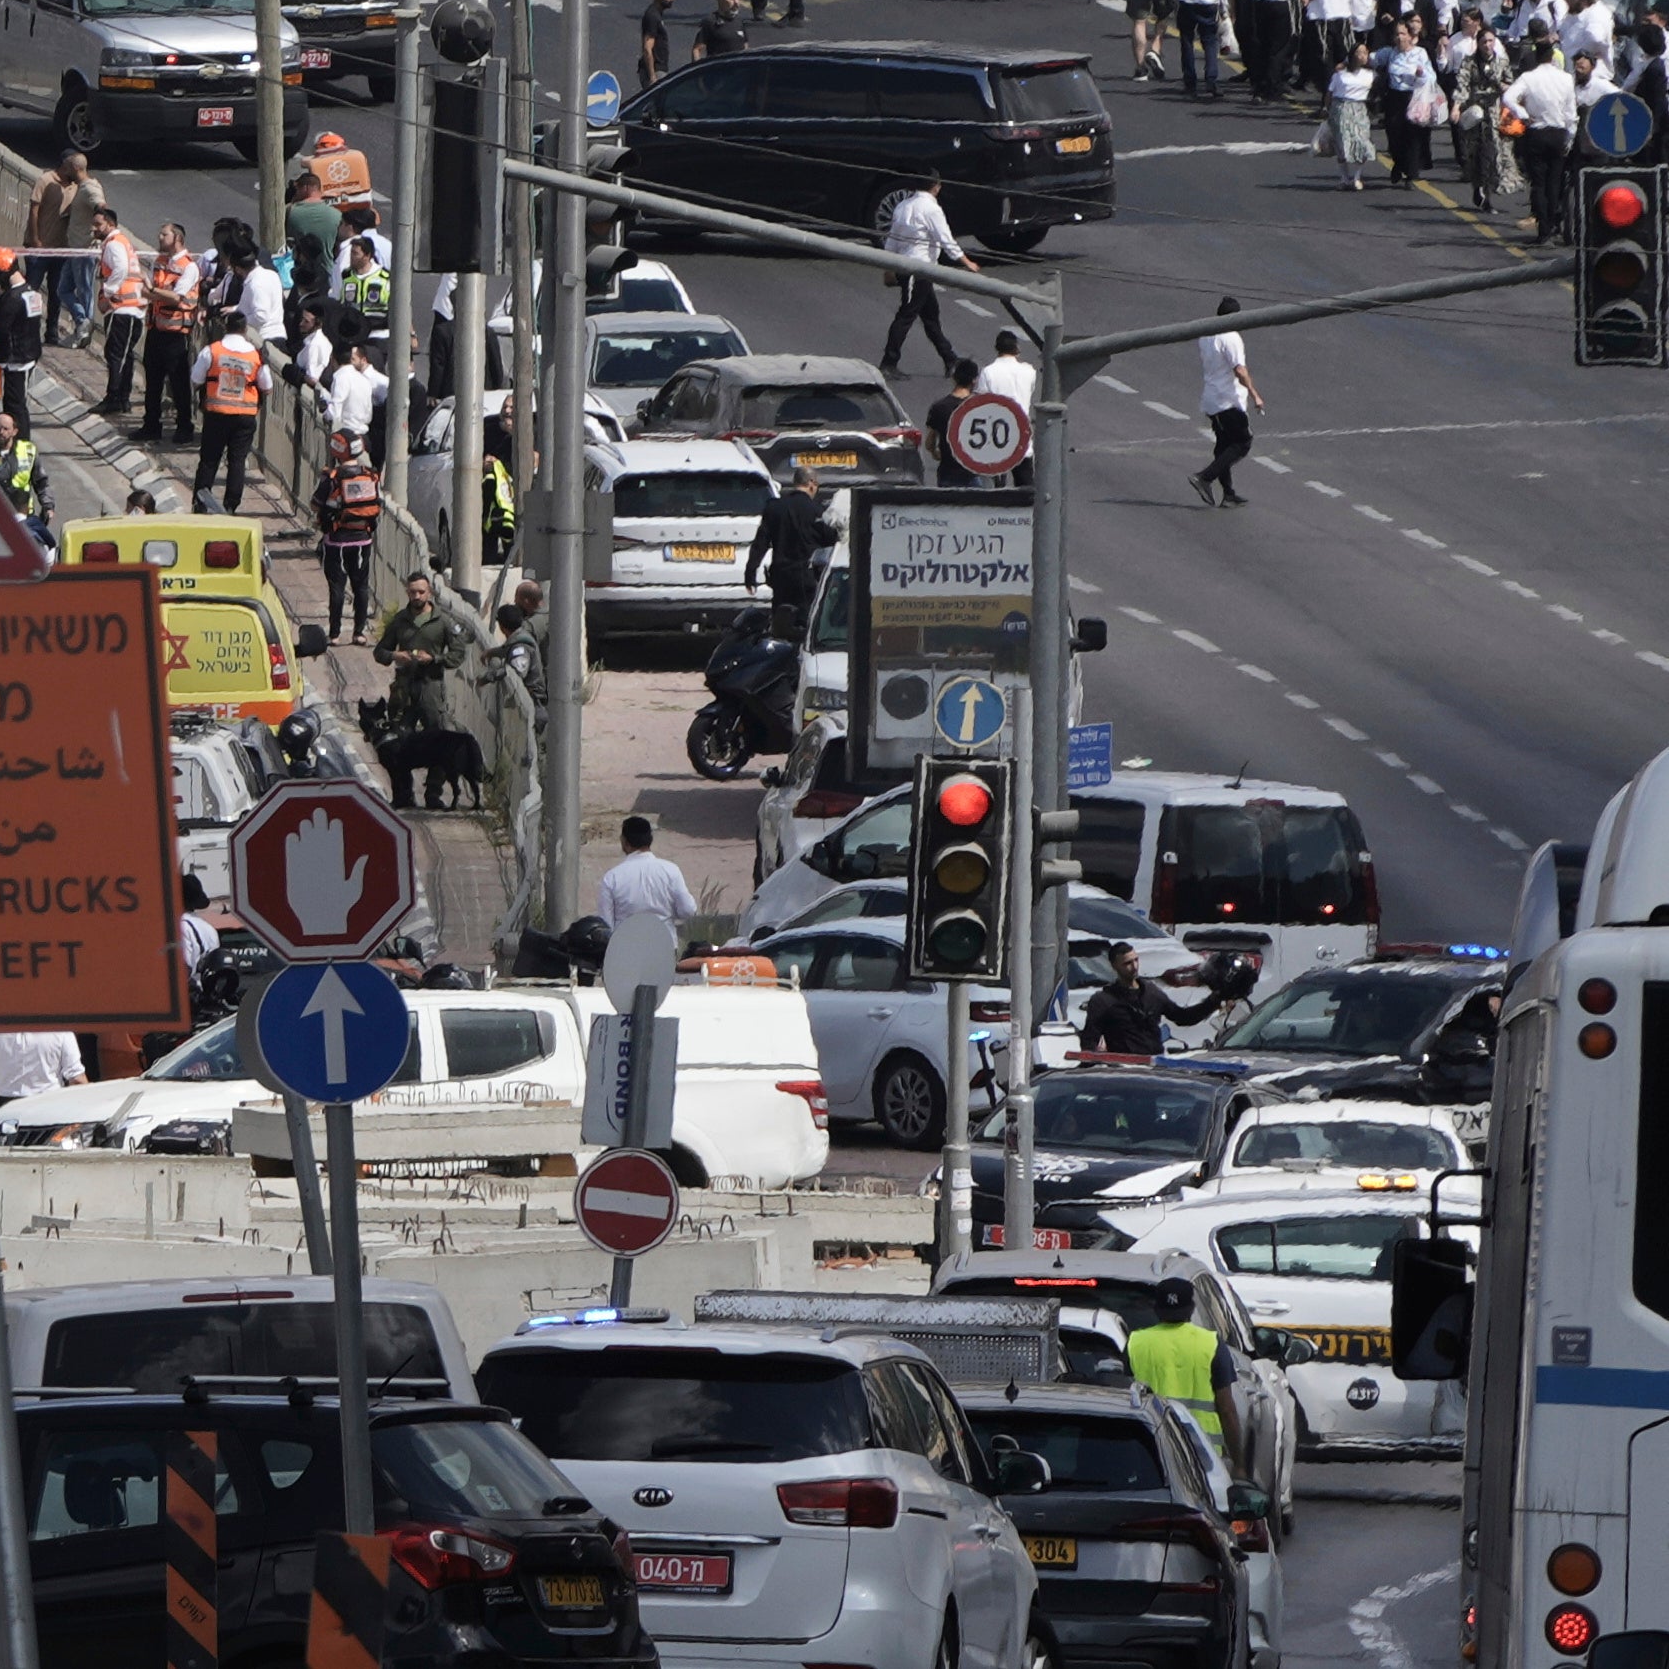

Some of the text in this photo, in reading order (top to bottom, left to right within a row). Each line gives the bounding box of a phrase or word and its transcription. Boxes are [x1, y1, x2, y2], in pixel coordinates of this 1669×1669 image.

[968, 419, 1009, 449] 50
[908, 534, 1005, 561] הגיע זמן
[882, 560, 1030, 588] אלקטרולוקס
[203, 630, 252, 646] מגן דוד
[216, 645, 252, 659] אדום
[196, 658, 252, 675] בישראל
[638, 1490, 669, 1503] KIA
